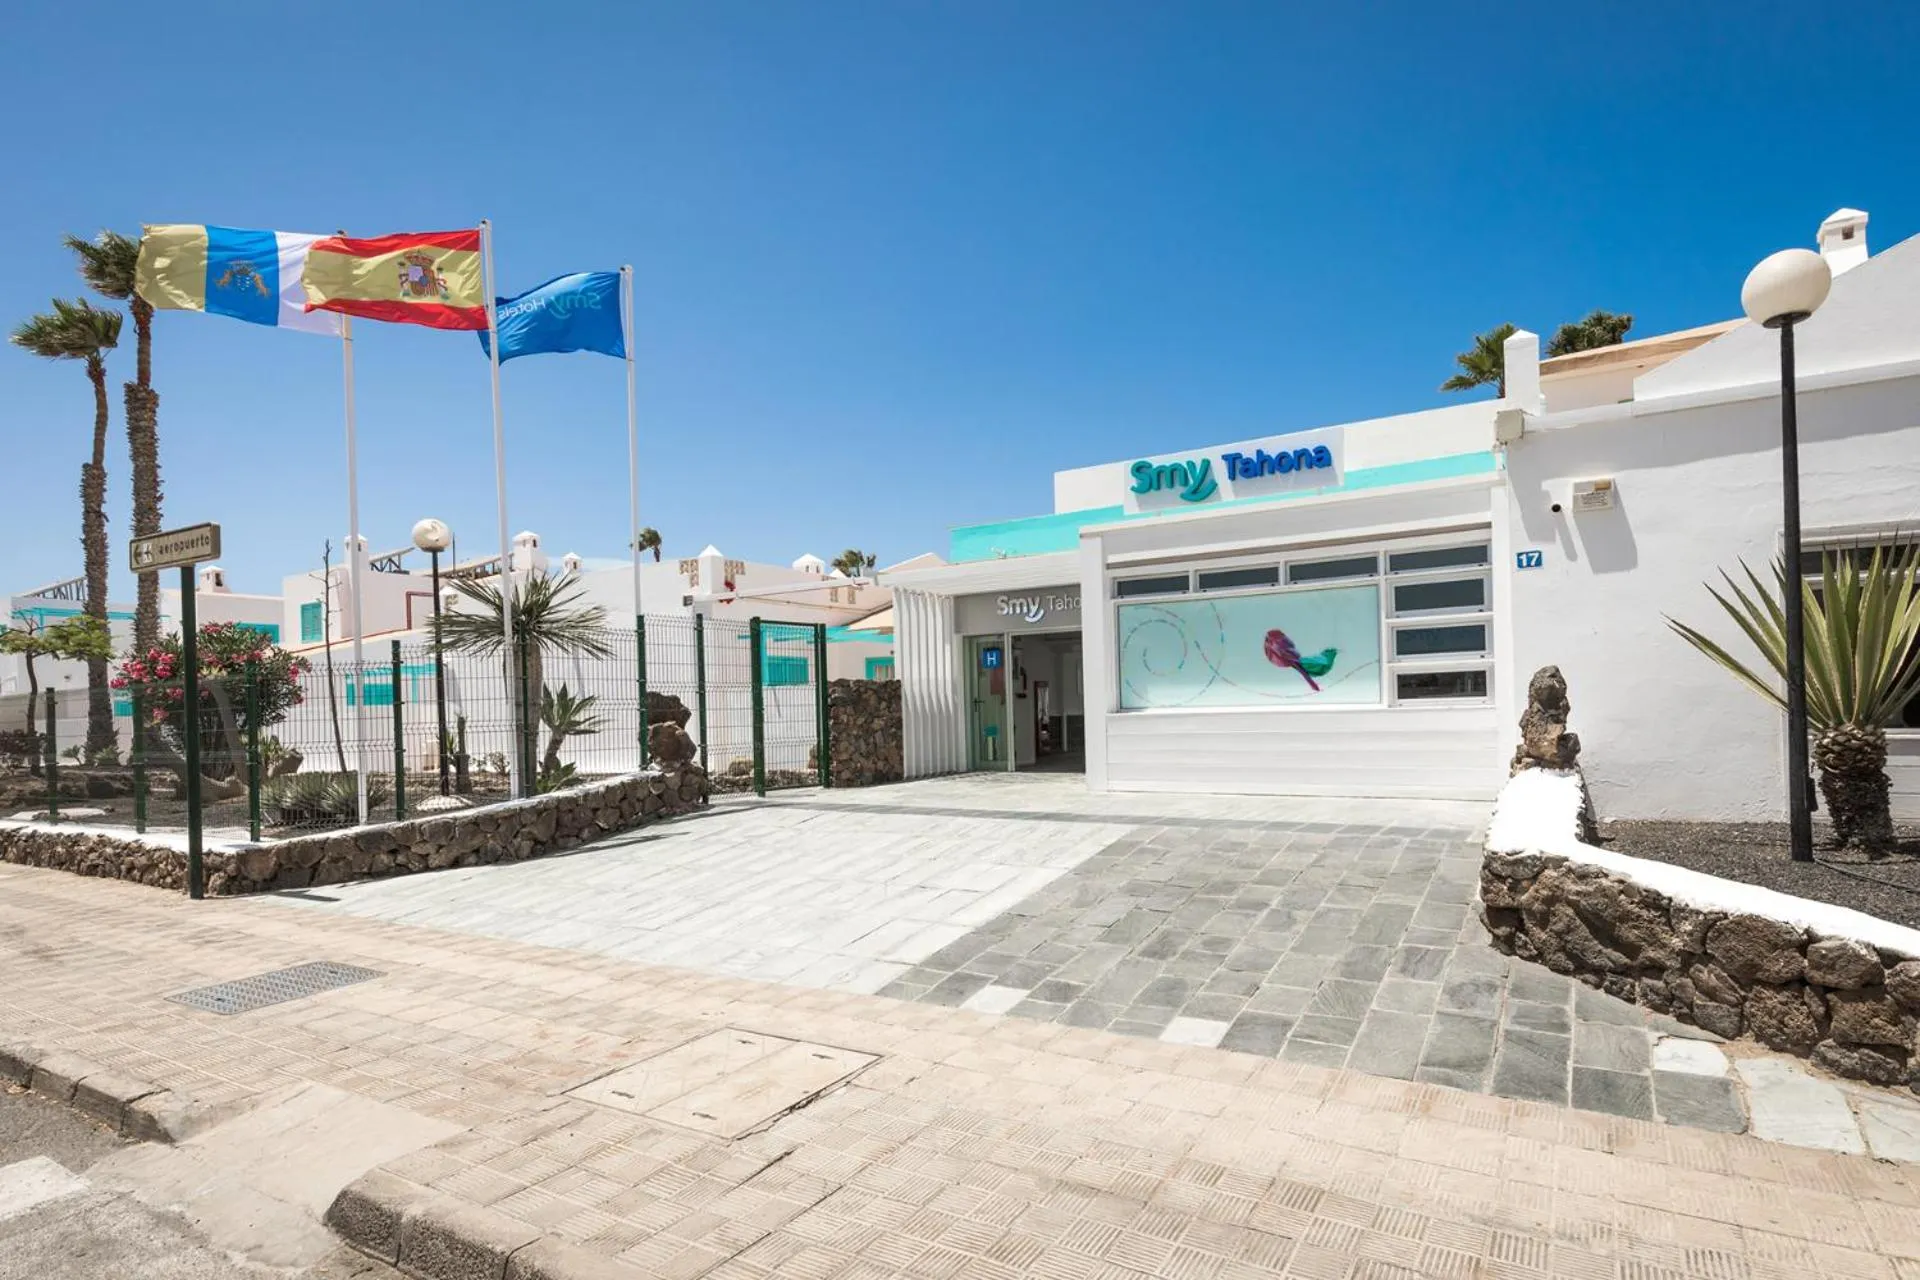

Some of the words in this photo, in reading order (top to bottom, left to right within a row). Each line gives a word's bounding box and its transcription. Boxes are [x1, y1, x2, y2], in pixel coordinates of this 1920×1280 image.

[1130, 458, 1218, 502] Smy
[1221, 445, 1332, 482] Tahona
[158, 534, 210, 554] aeropuerto
[1518, 552, 1540, 568] 17
[997, 594, 1044, 623] Smy
[986, 651, 998, 666] H
